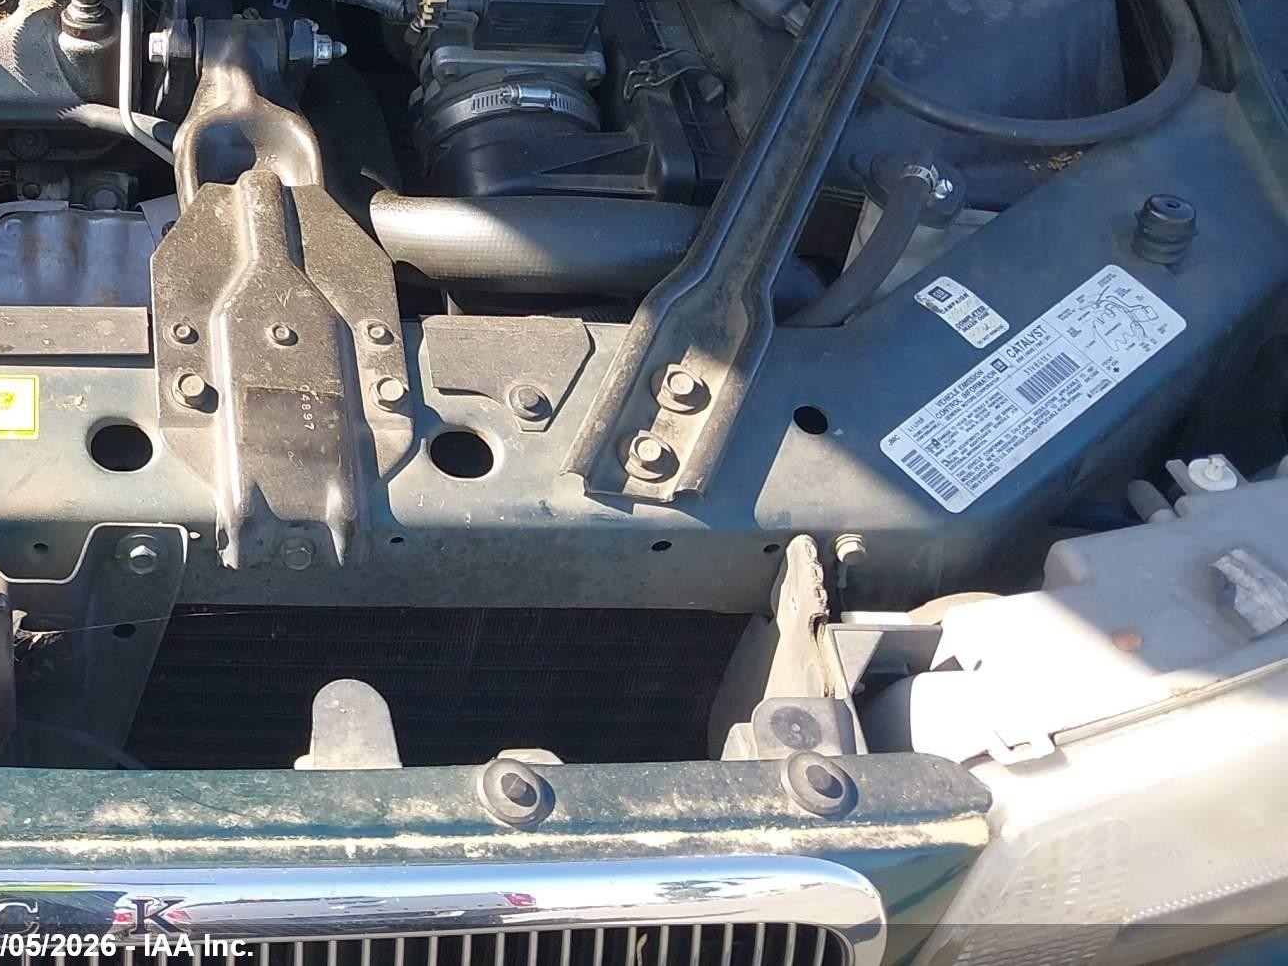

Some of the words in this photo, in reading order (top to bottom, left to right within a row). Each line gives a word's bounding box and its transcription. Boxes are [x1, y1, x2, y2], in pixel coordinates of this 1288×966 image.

[939, 291, 969, 314] CAMPAIGN
[955, 304, 986, 329] COMPLETED
[1004, 324, 1048, 359] CATALYST
[934, 396, 962, 419] CONTROL
[960, 369, 997, 399] INFORMATION
[935, 388, 959, 408] VEHICLE
[956, 368, 984, 390] EMISSION
